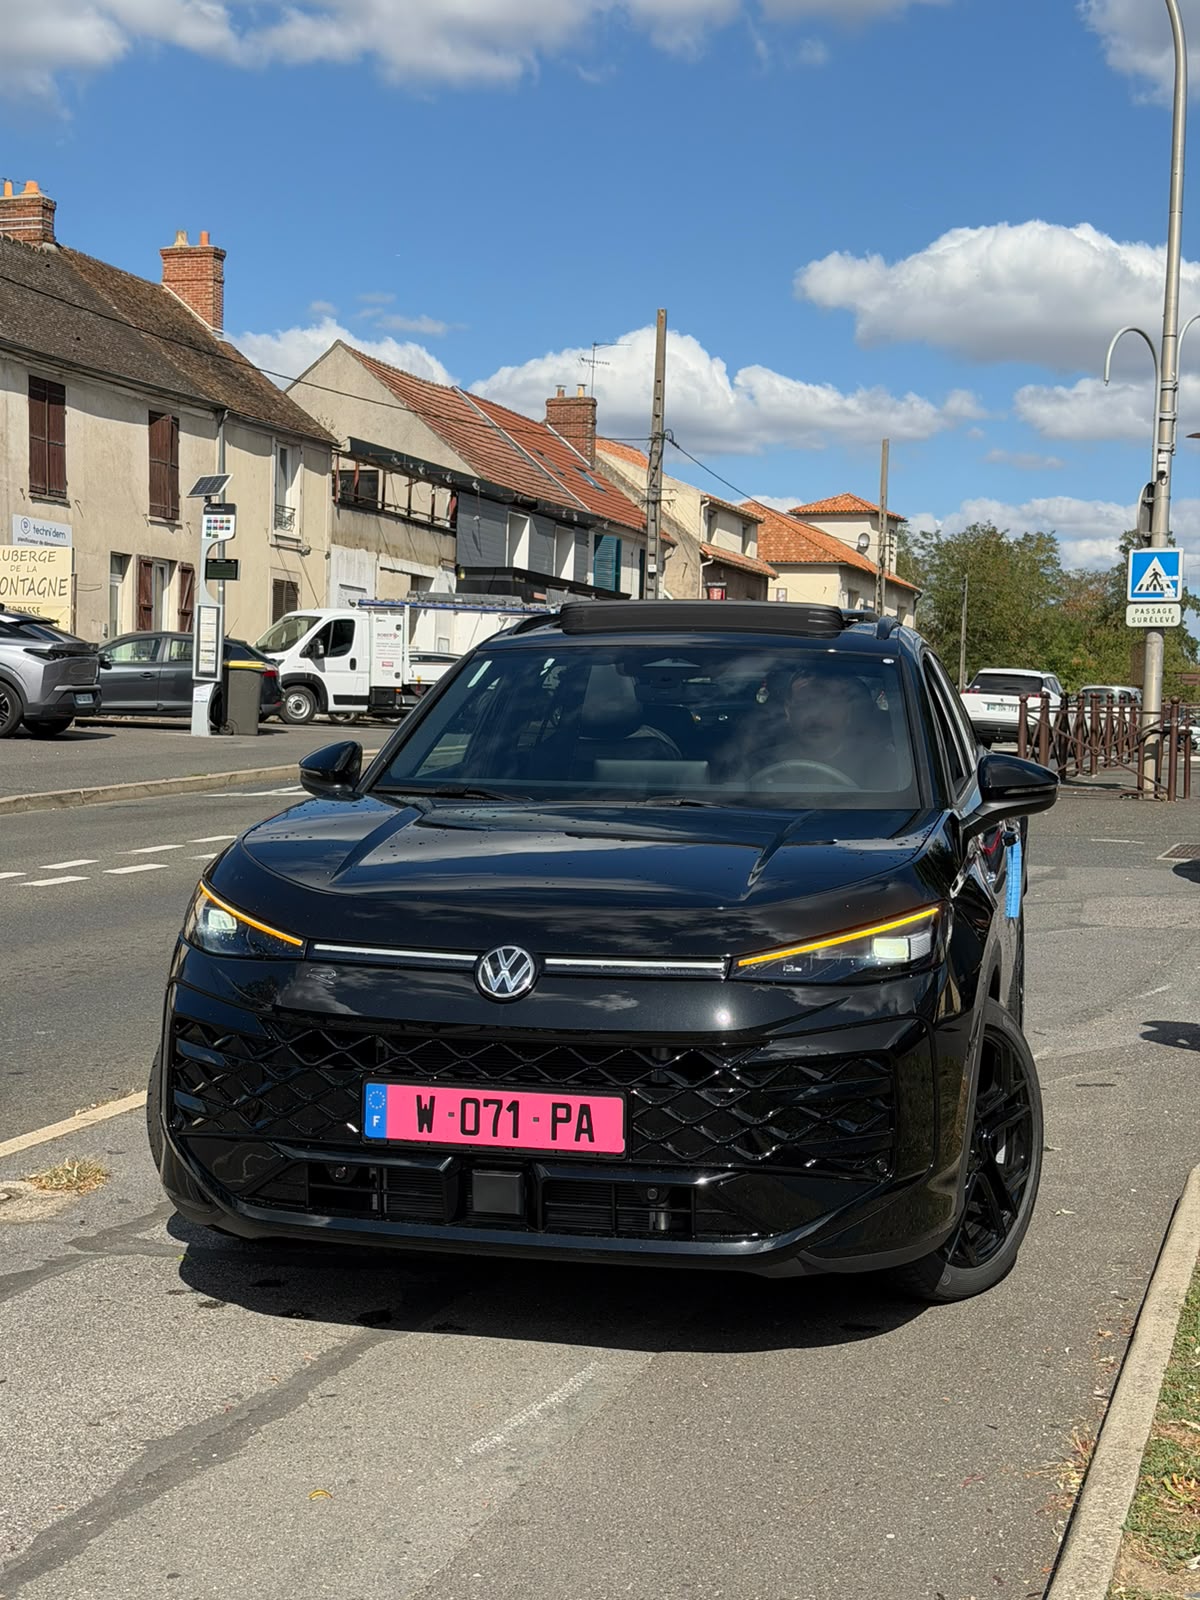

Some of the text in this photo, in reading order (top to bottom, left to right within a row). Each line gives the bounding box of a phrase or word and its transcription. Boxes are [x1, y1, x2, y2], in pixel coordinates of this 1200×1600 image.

[0, 549, 56, 563] UBERGE
[10, 565, 37, 573] DE LA
[0, 576, 68, 598] ONTAGNE
[1131, 615, 1175, 624] SURÉLEVÉ
[373, 1115, 381, 1127] F
